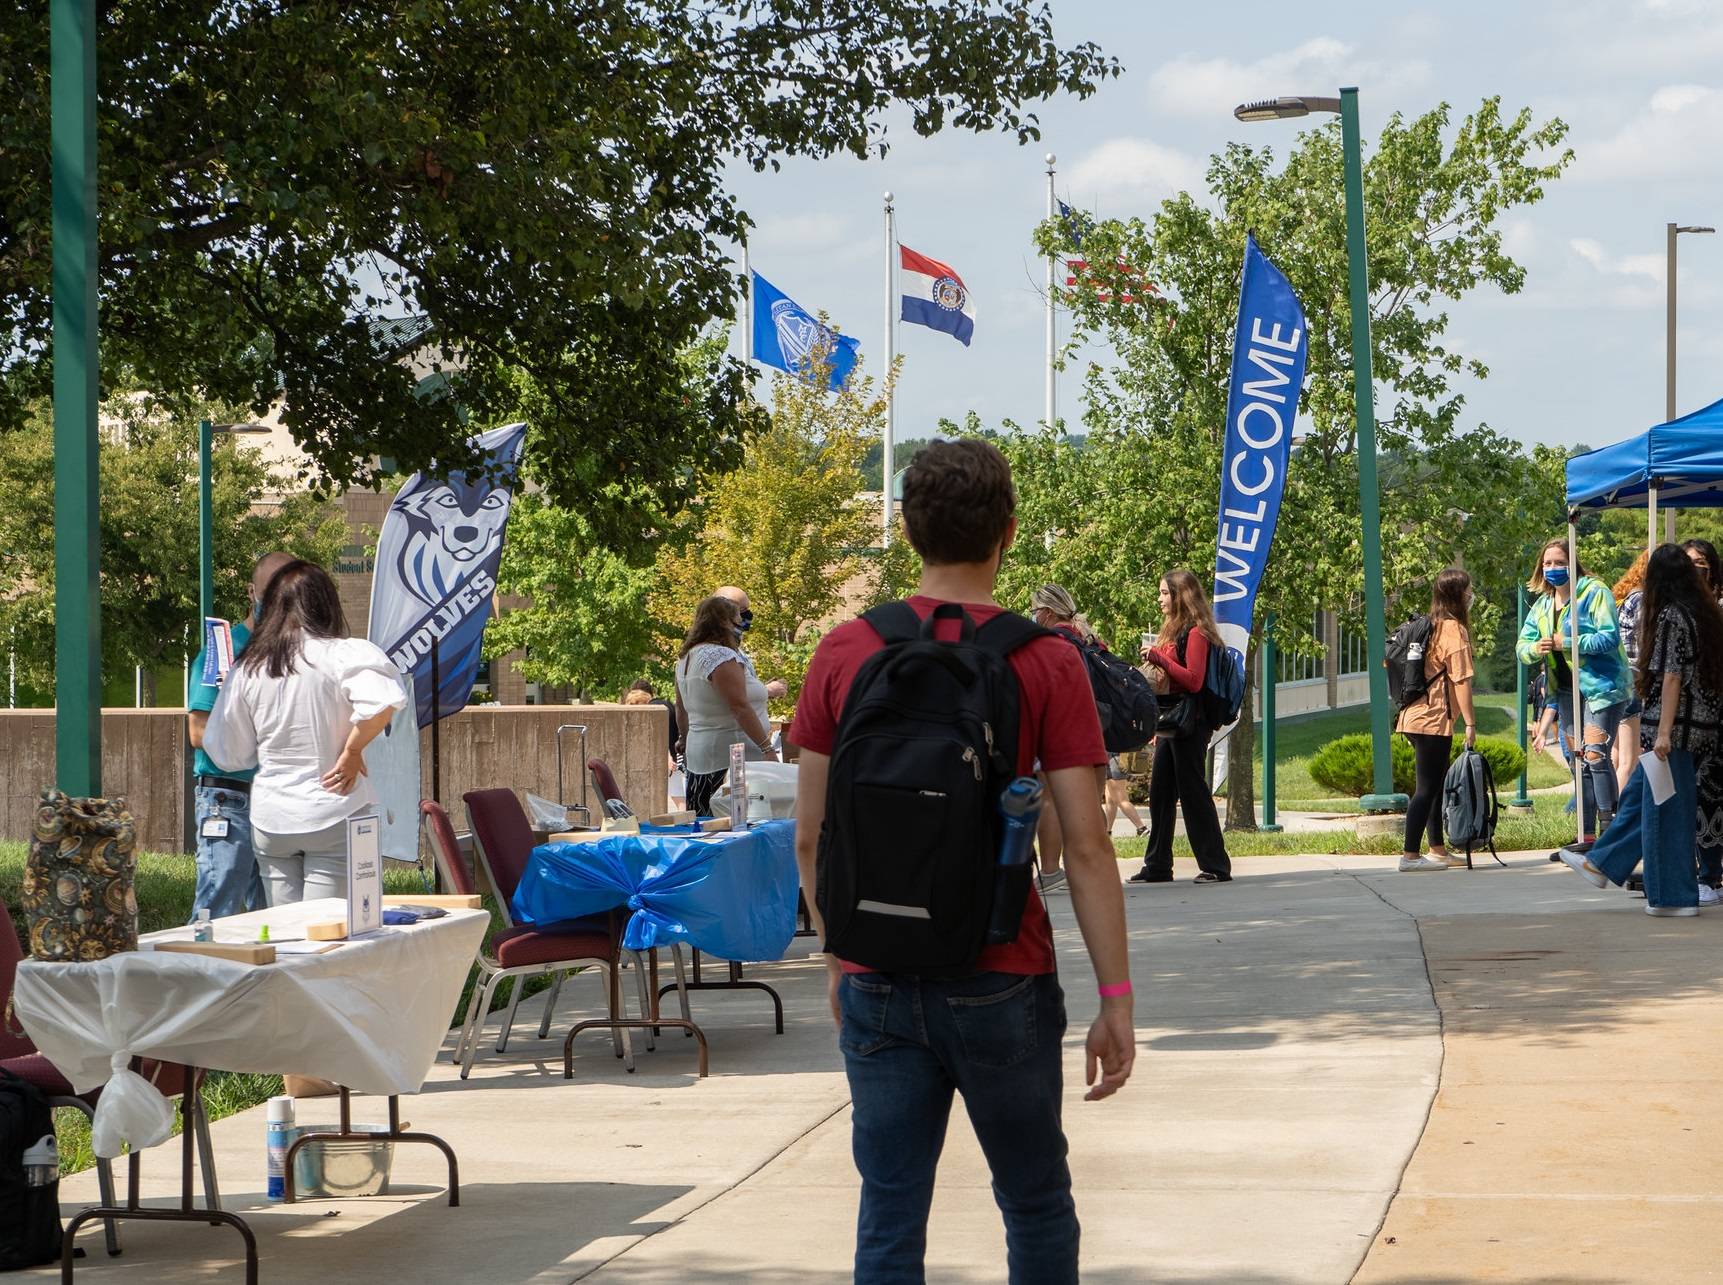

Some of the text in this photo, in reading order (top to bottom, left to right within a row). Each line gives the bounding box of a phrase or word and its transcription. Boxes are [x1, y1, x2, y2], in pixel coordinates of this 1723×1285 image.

[1213, 317, 1301, 603] WELCOME
[333, 561, 364, 573] Student
[390, 569, 496, 674] WOLVES
